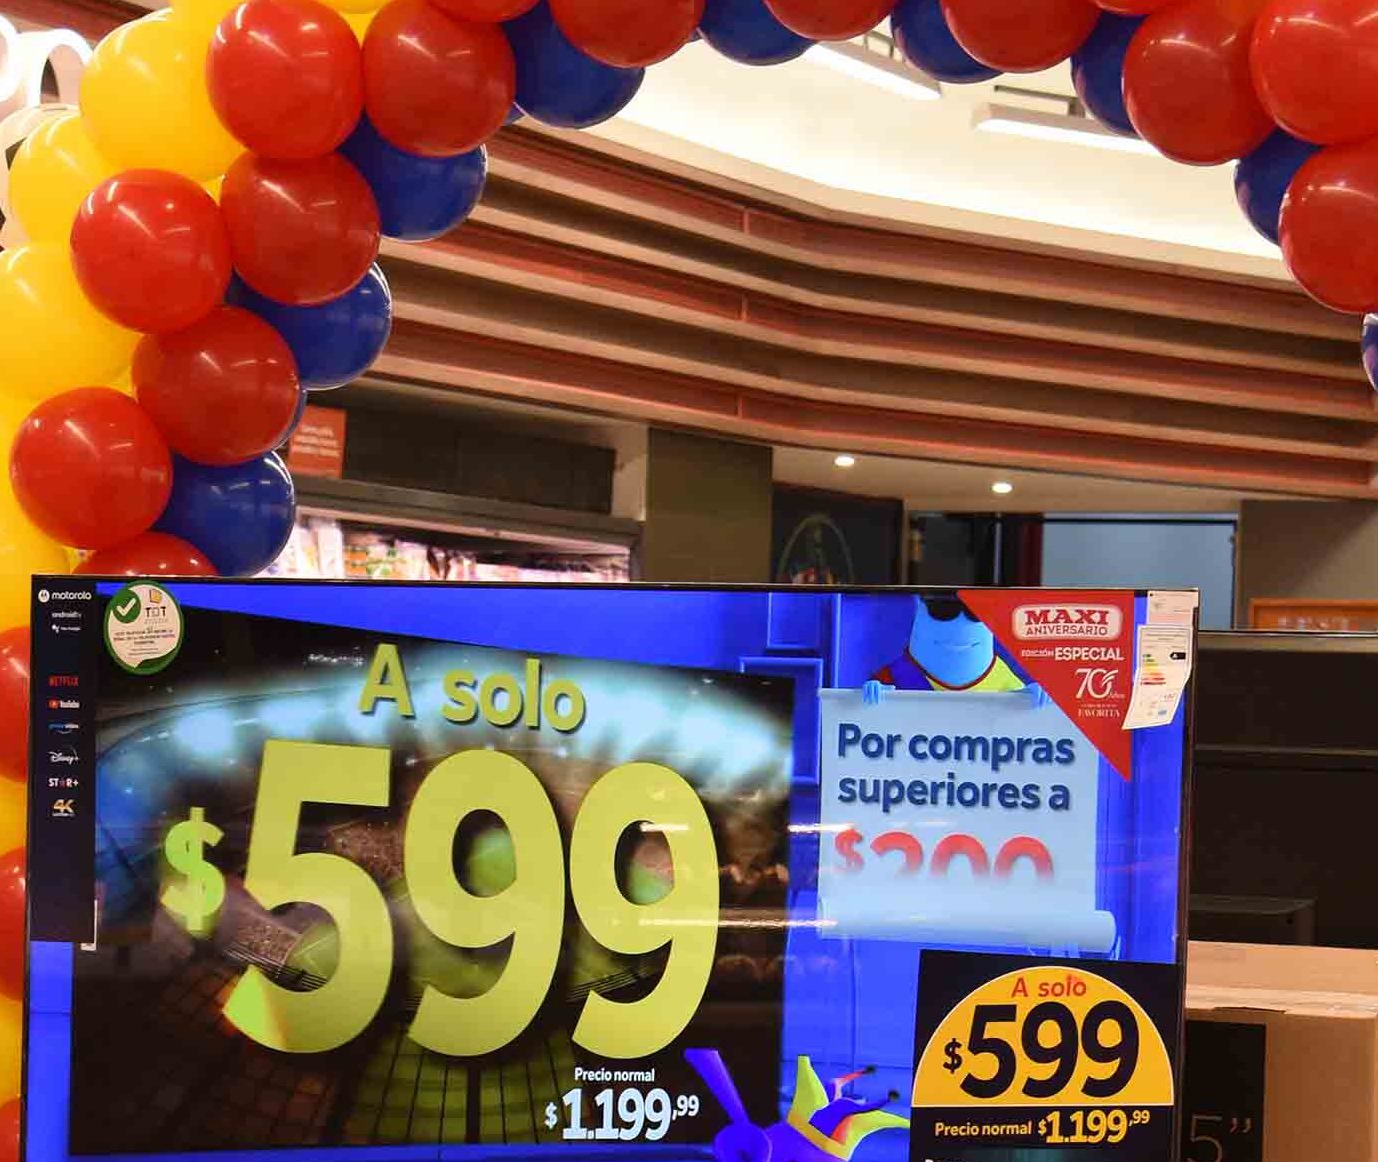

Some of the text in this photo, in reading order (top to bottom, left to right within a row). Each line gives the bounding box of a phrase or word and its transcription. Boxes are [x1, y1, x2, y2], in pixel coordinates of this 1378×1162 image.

[51, 589, 92, 600] motorola
[1025, 609, 1110, 625] MAXI
[1026, 625, 1108, 636] ANIVERSARIO
[1055, 646, 1124, 661] ESPECIAL
[49, 675, 79, 687] NETFLIX
[359, 643, 586, 734] A solo
[1075, 667, 1119, 699] 70
[838, 723, 1076, 772] Por compras
[838, 772, 1071, 814] superiores a
[53, 799, 75, 814] 4K
[161, 740, 720, 1060] $599
[1011, 974, 1087, 998] A solo
[942, 1000, 1140, 1099] $599
[574, 1067, 655, 1082] Precio normal
[935, 1121, 980, 1137] Precio
[982, 1120, 1032, 1136] normal
